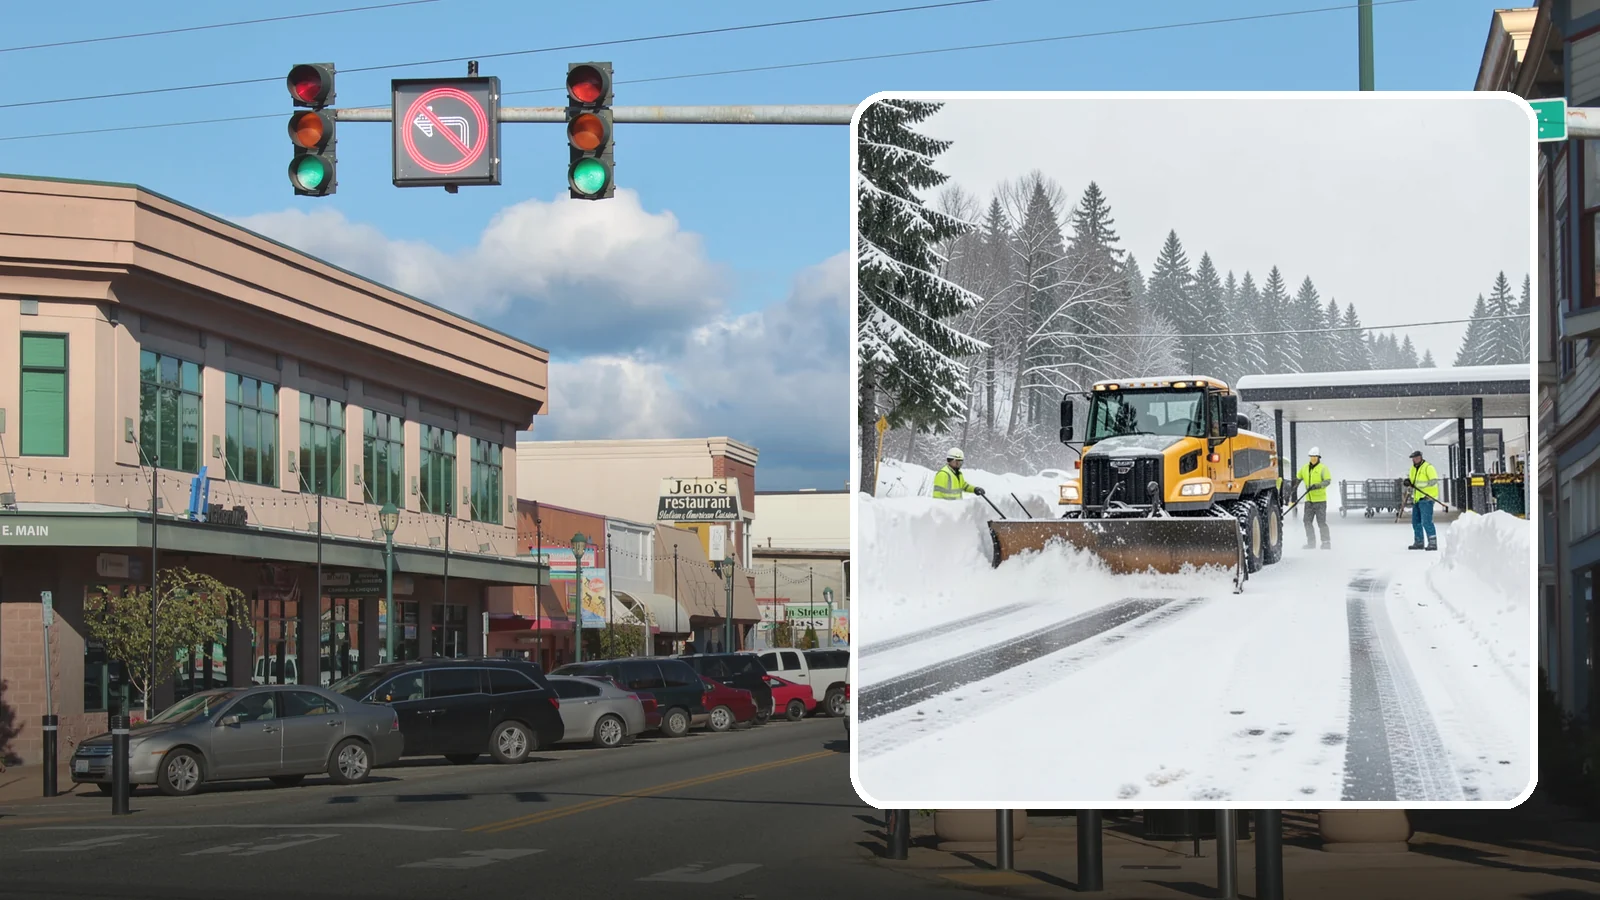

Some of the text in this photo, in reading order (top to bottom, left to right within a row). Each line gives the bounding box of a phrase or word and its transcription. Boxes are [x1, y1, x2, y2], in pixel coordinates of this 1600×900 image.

[670, 480, 727, 494] Jeno's
[665, 496, 731, 509] restaurant
[659, 510, 682, 520] Italian
[686, 509, 715, 519] American
[715, 509, 737, 519] Cuisine
[2, 525, 49, 536] E. MAIN
[797, 607, 829, 617] Street
